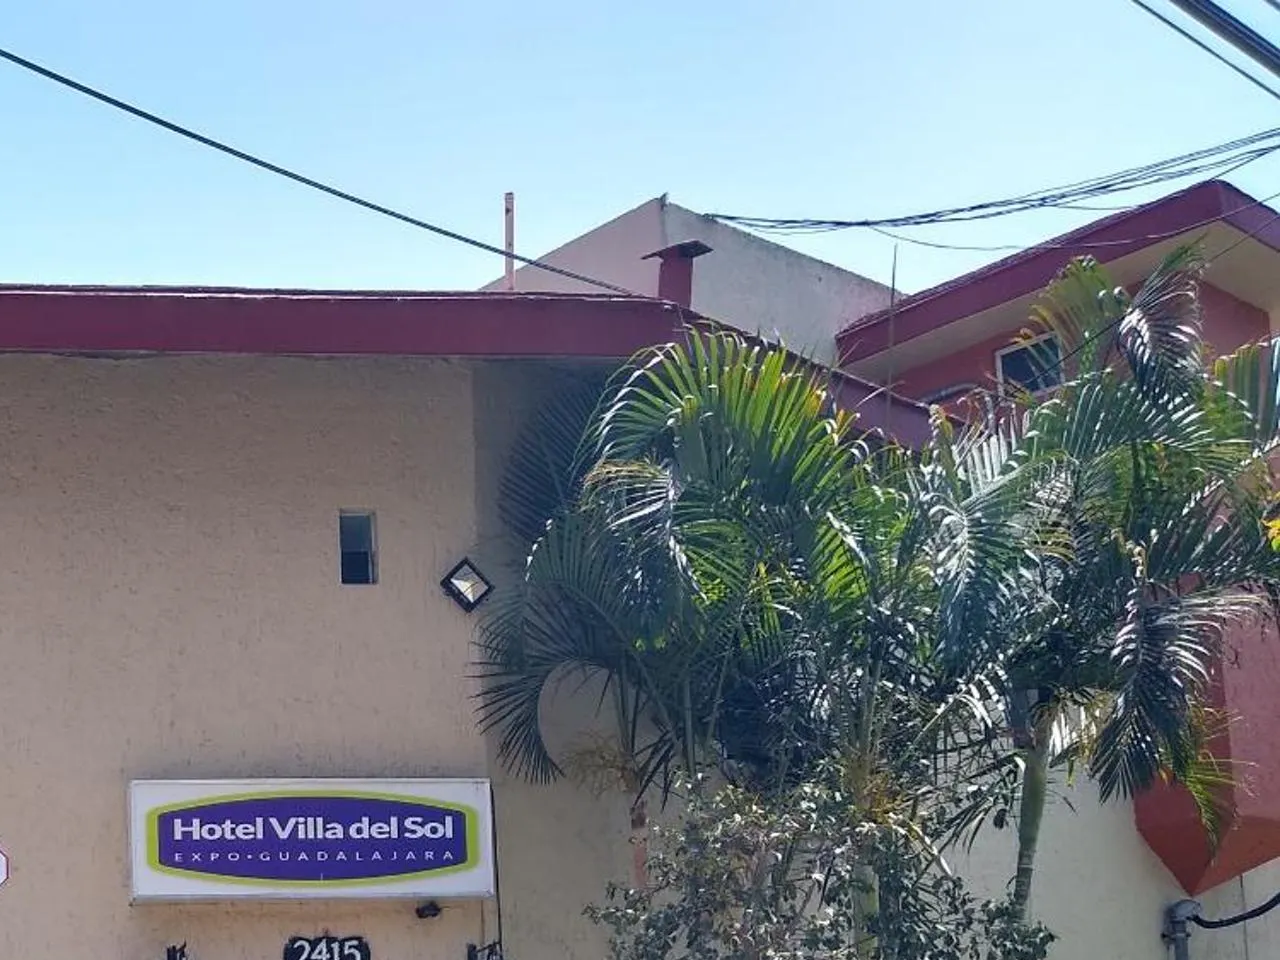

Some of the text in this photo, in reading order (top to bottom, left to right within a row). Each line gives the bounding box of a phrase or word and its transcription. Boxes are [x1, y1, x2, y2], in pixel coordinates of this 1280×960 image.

[173, 814, 453, 841] Hotel Villa del Sol
